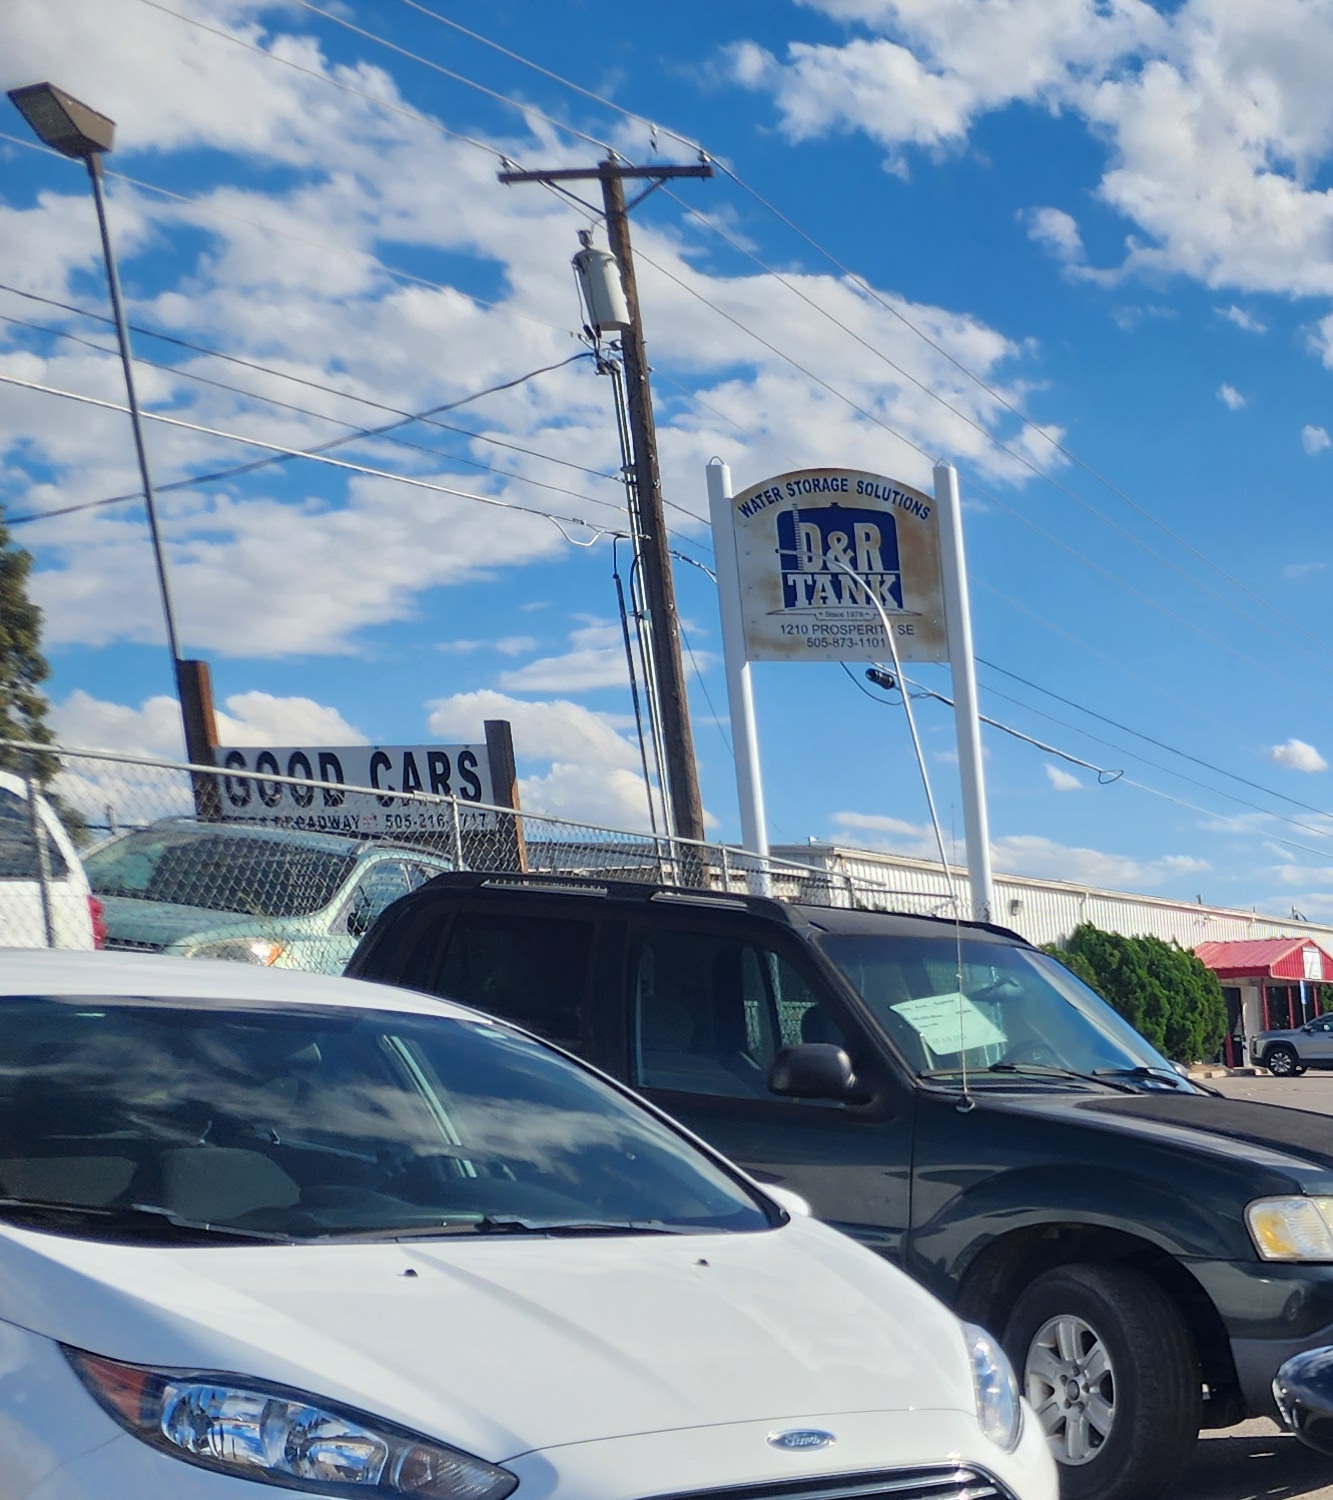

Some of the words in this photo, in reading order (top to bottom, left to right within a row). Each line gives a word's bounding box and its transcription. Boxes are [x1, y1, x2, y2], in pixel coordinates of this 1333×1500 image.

[738, 486, 784, 518] WATER
[785, 477, 849, 498] STORAGE
[856, 480, 931, 520] SOLUTIONS
[799, 522, 885, 571] D&R
[786, 573, 897, 608] TANK
[780, 624, 808, 635] 1210
[812, 624, 893, 635] PROSPERIT
[898, 624, 915, 635] SE
[807, 637, 885, 648] 505-873-1101
[224, 751, 346, 808] GOOD
[370, 750, 483, 808] CARS
